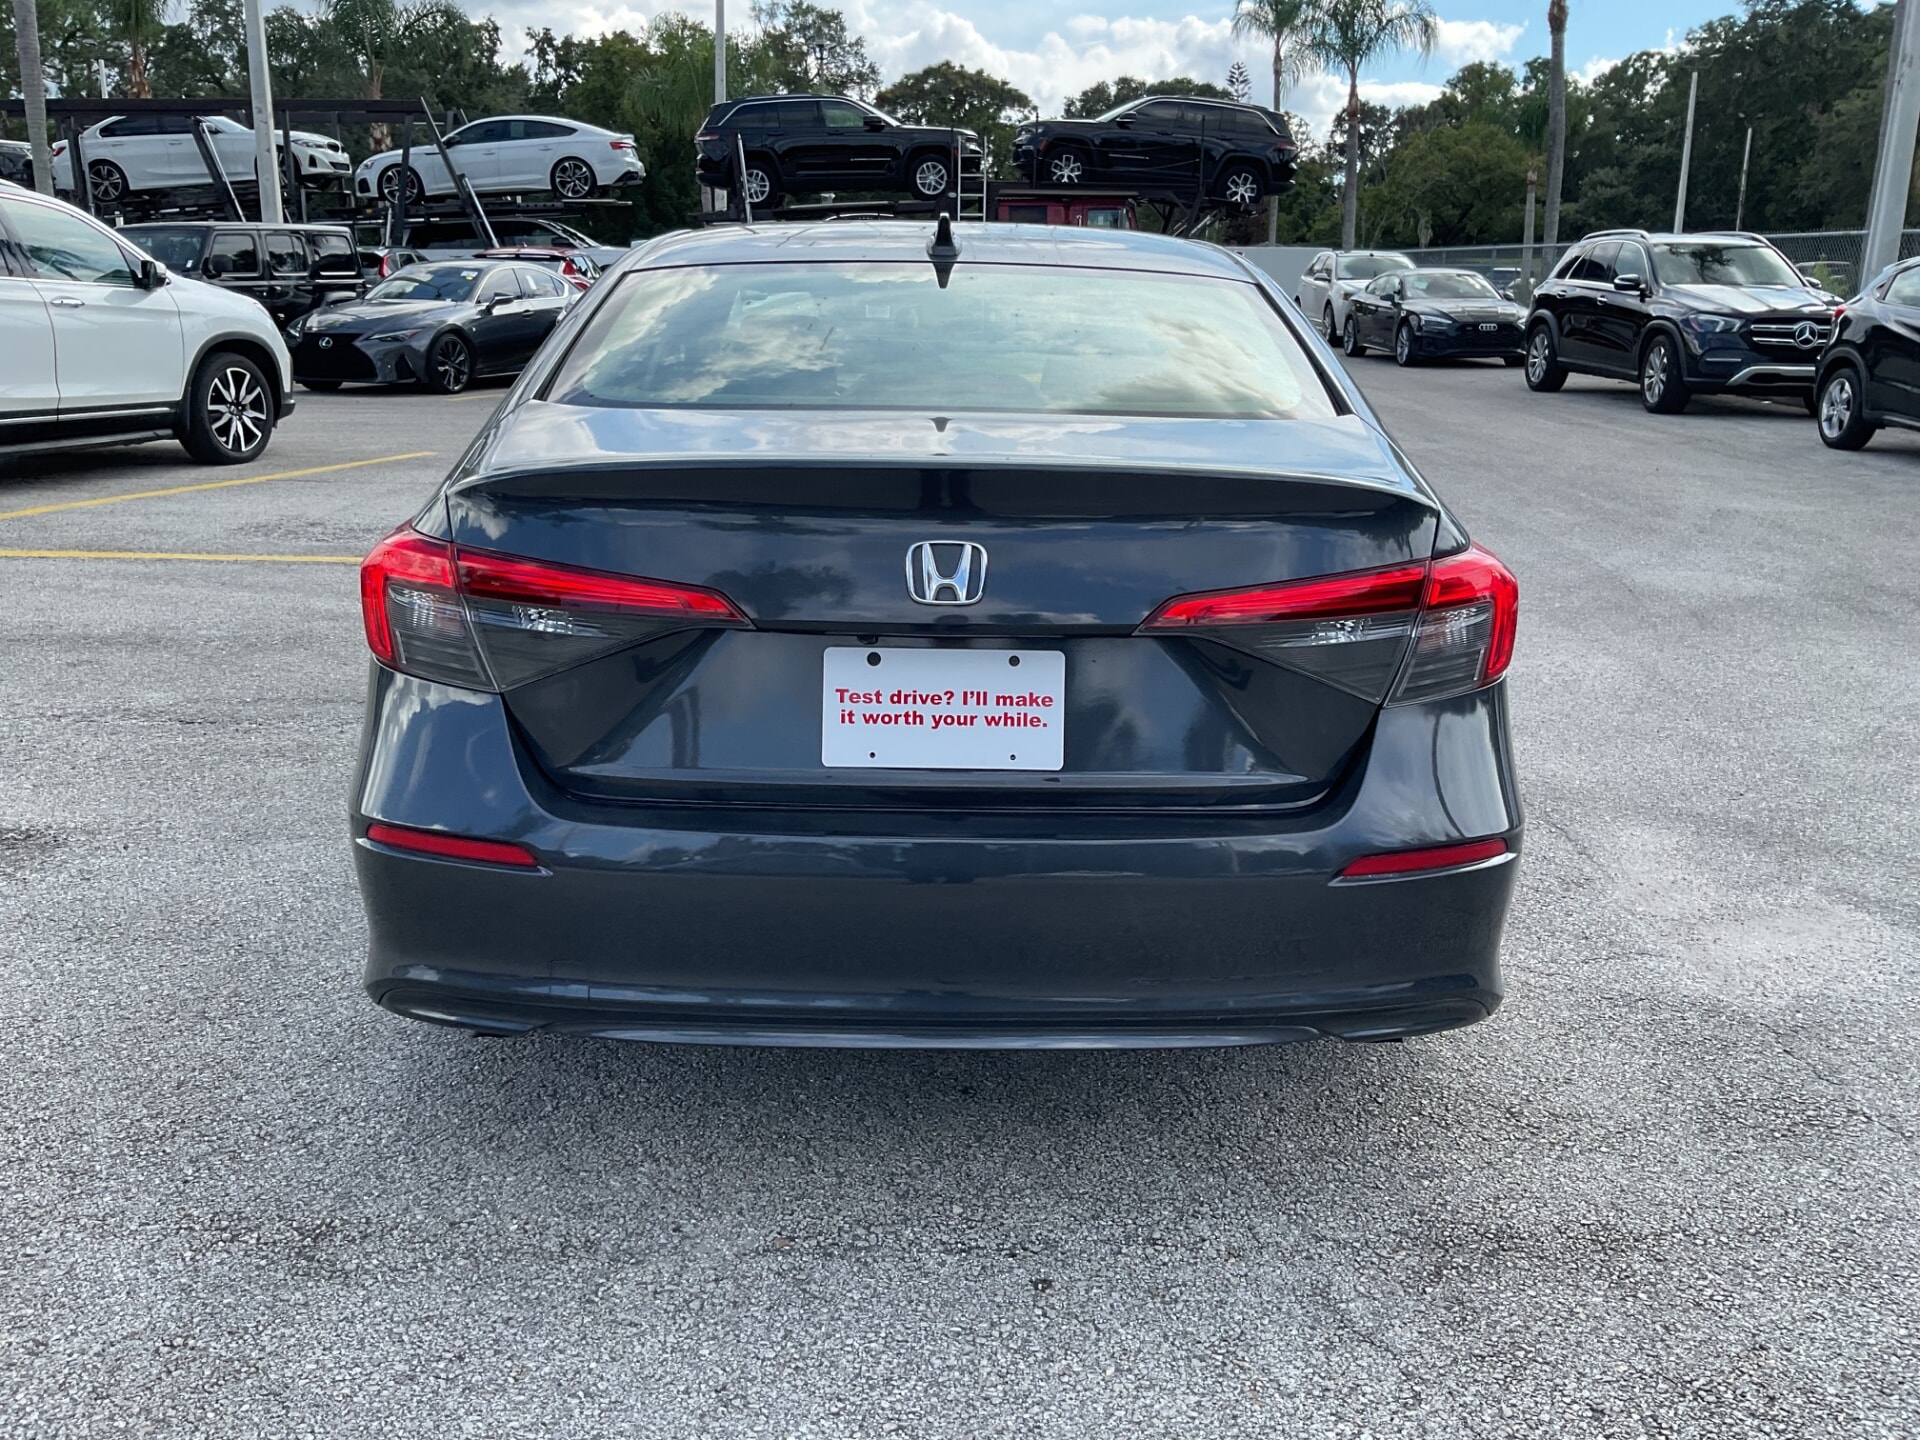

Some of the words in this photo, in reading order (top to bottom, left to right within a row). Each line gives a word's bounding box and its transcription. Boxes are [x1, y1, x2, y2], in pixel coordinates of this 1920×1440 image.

[835, 688, 882, 705] Test
[889, 690, 954, 706] drive?
[995, 692, 1054, 707] make
[840, 709, 855, 725] it
[862, 710, 925, 726] worth
[931, 714, 977, 729] your
[984, 712, 1048, 728] while.
